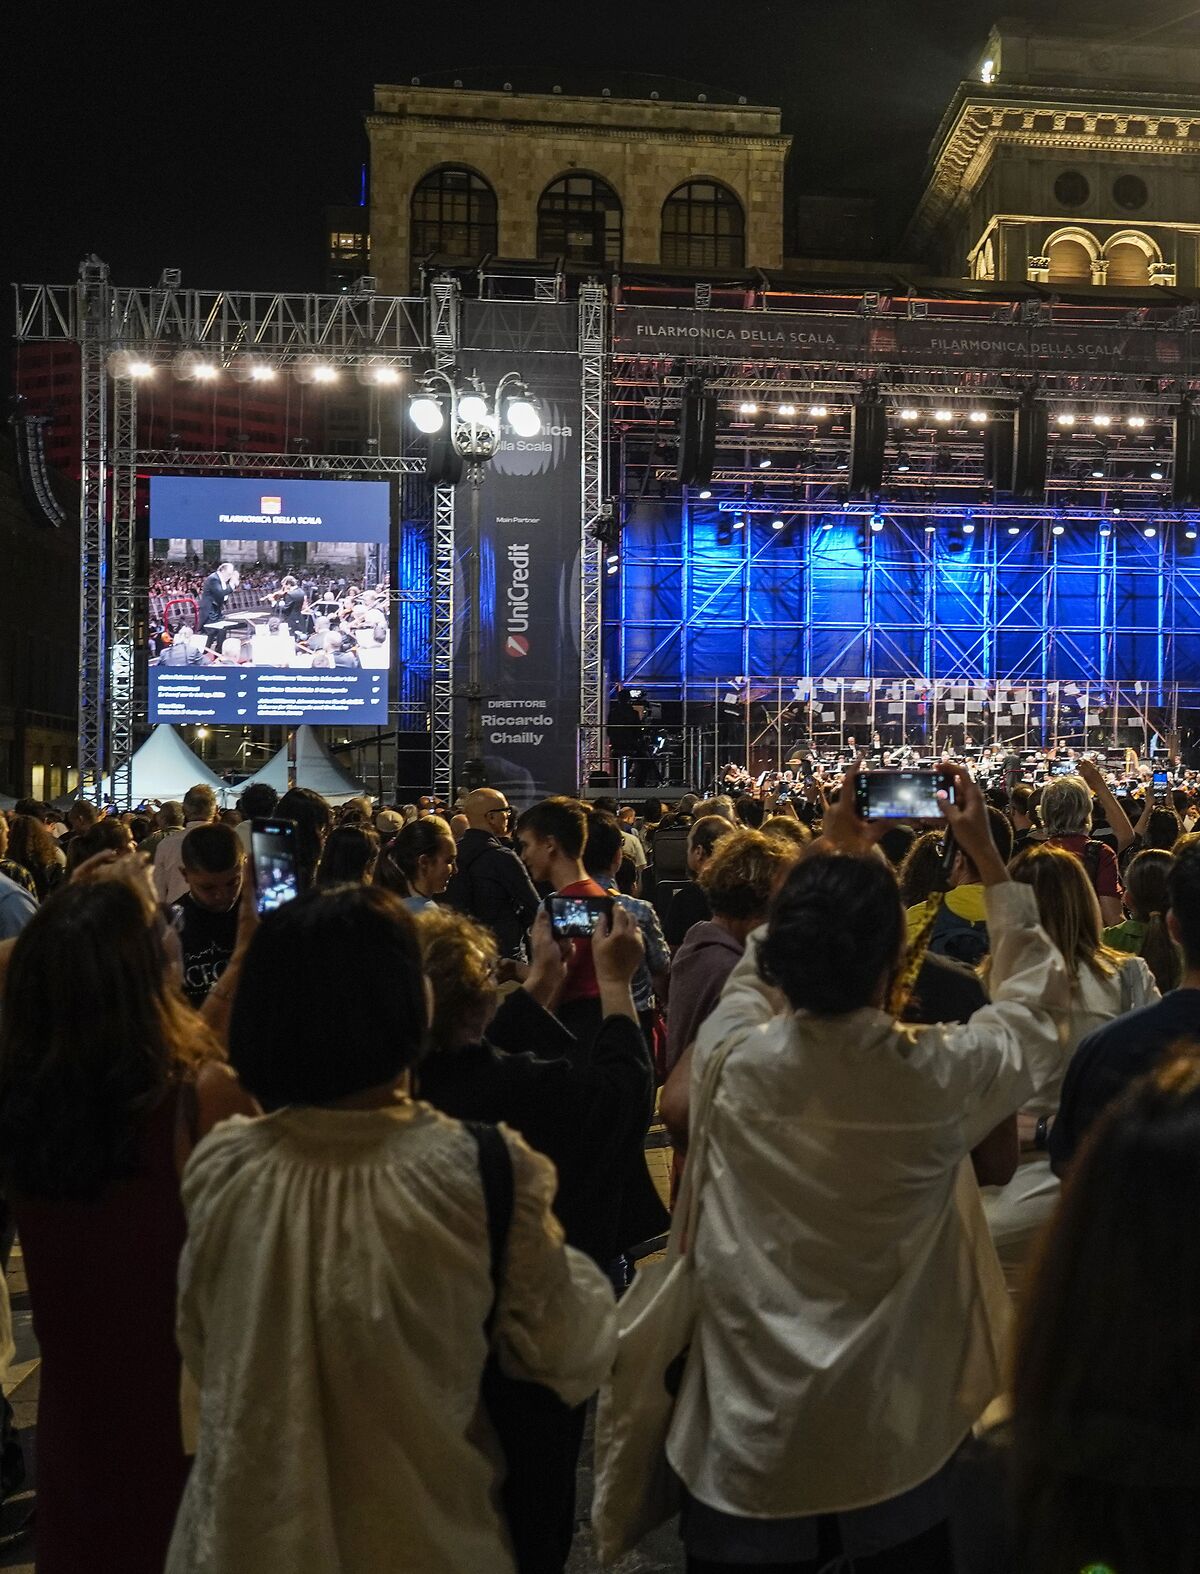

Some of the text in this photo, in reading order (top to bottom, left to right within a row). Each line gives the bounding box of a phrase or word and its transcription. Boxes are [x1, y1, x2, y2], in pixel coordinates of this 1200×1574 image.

[636, 325, 836, 344] FILARMONICA DELLA SCALA
[930, 339, 1121, 356] FILARMONICA DELLA SCALA
[516, 440, 553, 452] Scala
[507, 543, 529, 632] UniCredit
[488, 700, 547, 708] DIRETTORE
[481, 714, 553, 726] Riccardo
[490, 732, 544, 745] Chailly
